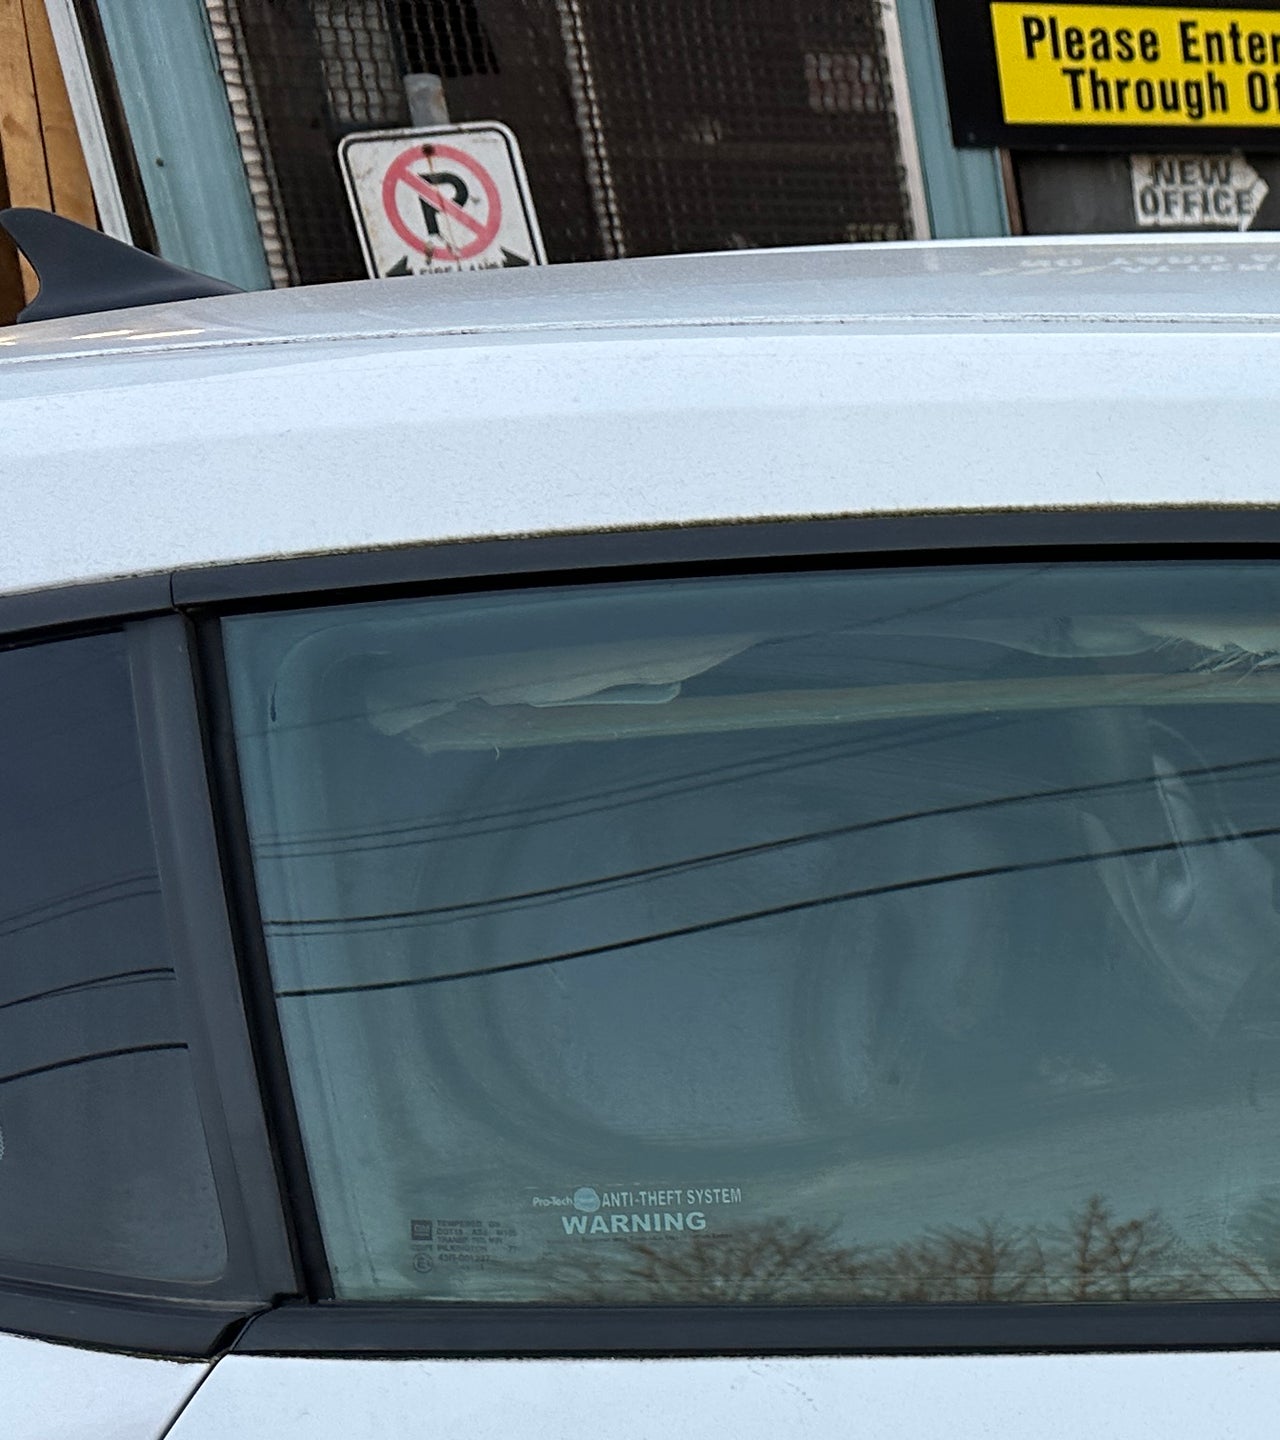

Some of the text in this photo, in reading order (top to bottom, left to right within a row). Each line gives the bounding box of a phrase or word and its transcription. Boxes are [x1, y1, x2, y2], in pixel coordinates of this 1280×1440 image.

[1022, 15, 1161, 63] Please
[1061, 67, 1228, 119] Through
[1150, 158, 1232, 186] NEW
[1140, 186, 1256, 216] OFFICE
[602, 1190, 683, 1208] ANTI-THEFT
[687, 1188, 742, 1205] SYSTEM
[561, 1211, 707, 1234] WARNING
